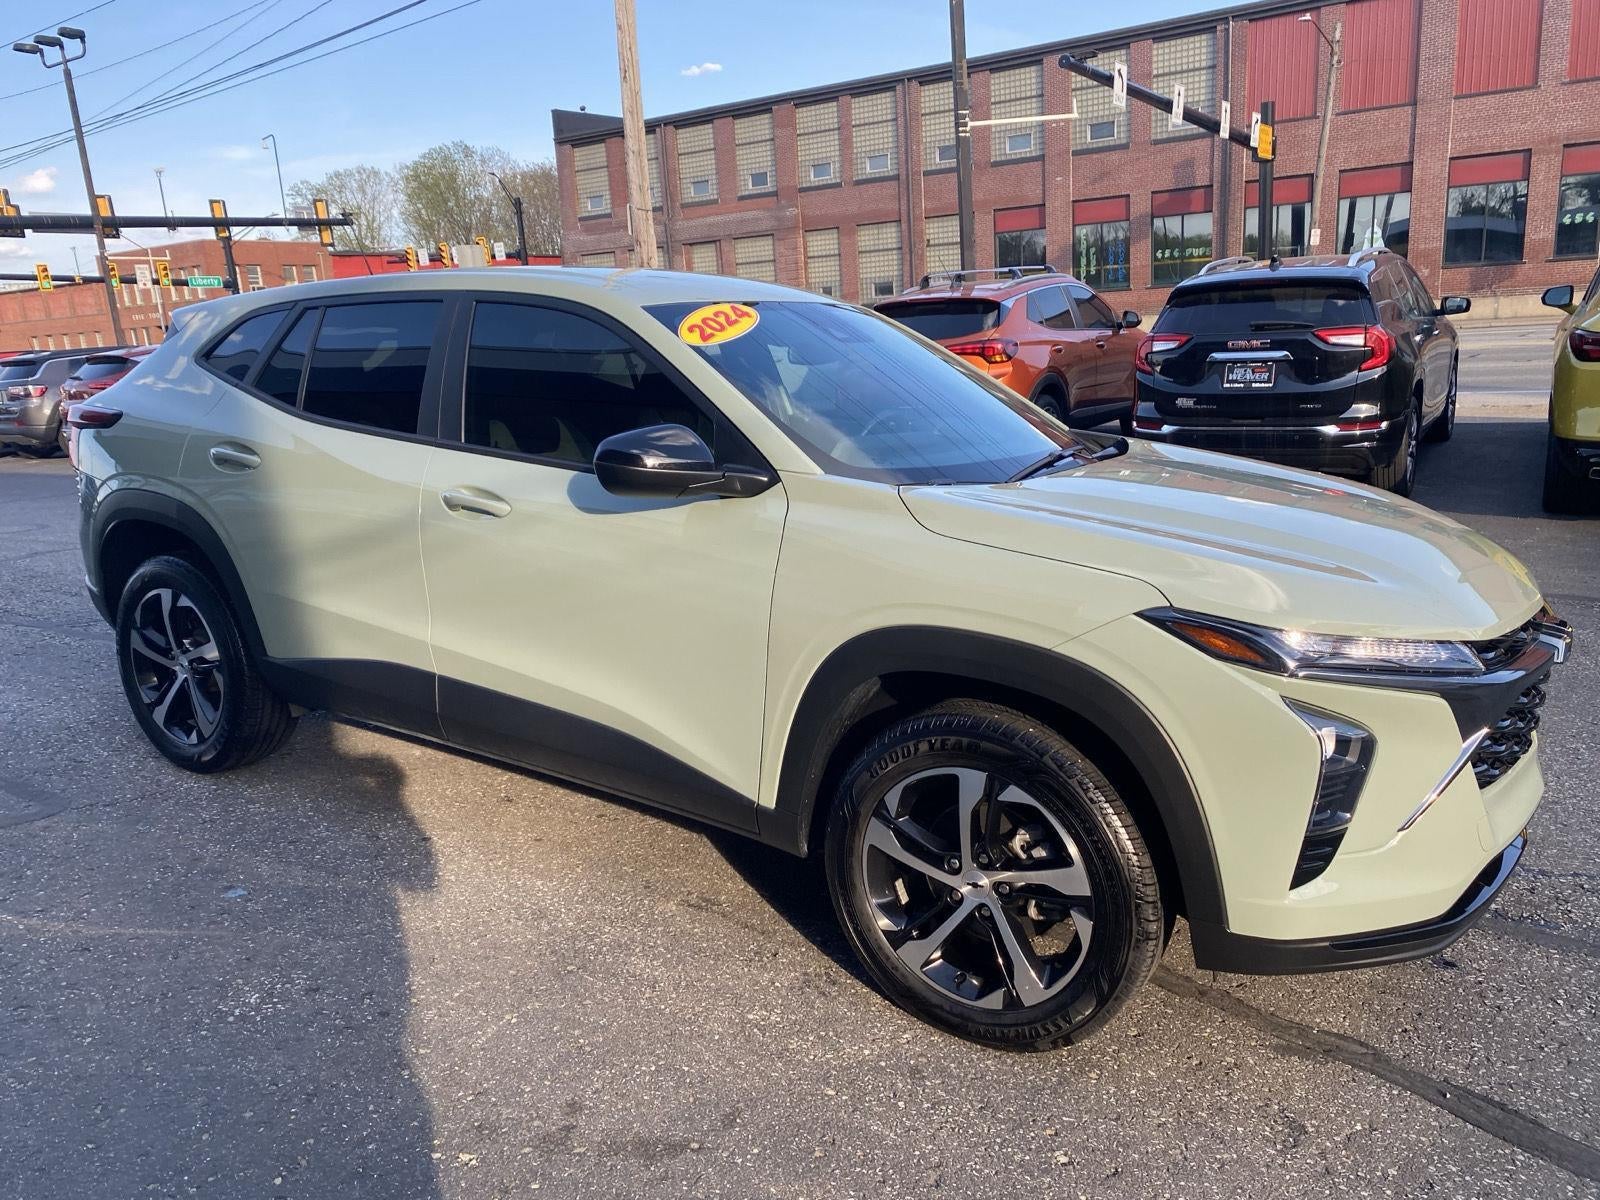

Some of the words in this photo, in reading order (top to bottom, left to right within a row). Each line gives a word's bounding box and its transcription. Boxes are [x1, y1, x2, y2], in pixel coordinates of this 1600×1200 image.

[192, 276, 218, 285] Liberty
[687, 303, 753, 342] 2024
[1227, 339, 1271, 349] GMC
[1228, 372, 1270, 381] WEAVER
